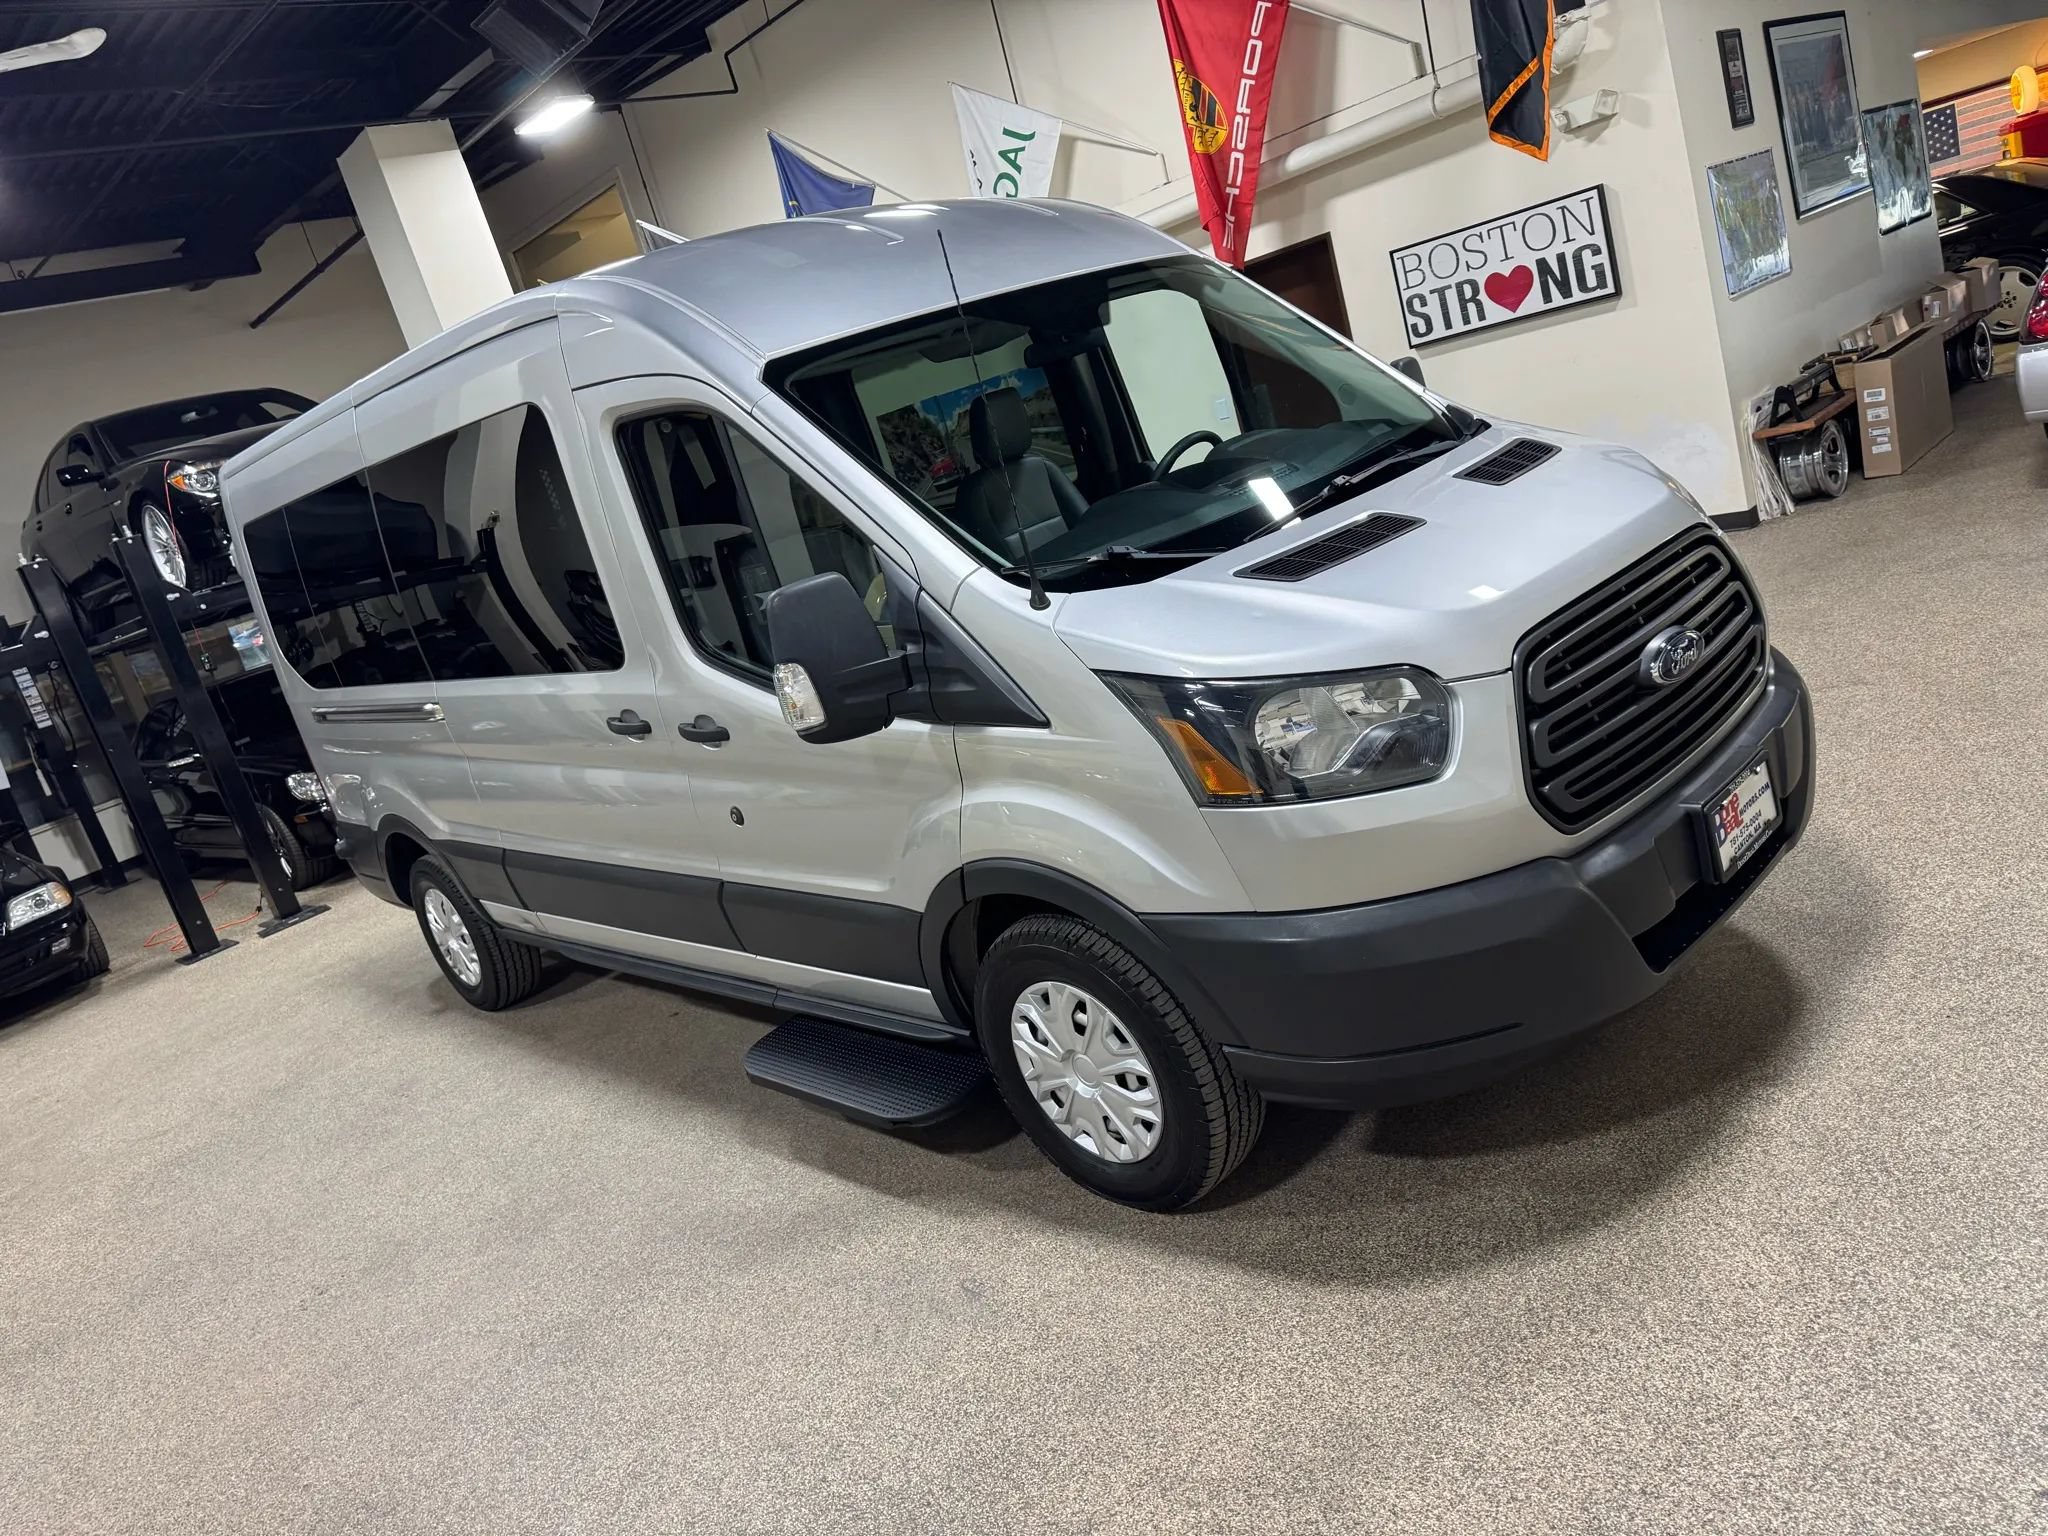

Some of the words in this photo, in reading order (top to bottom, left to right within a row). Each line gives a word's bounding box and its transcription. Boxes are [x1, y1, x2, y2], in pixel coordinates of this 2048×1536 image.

[1396, 196, 1596, 291] BOSTON
[1671, 639, 1698, 675] Ford
[1740, 782, 1770, 816] MOTORS.COM
